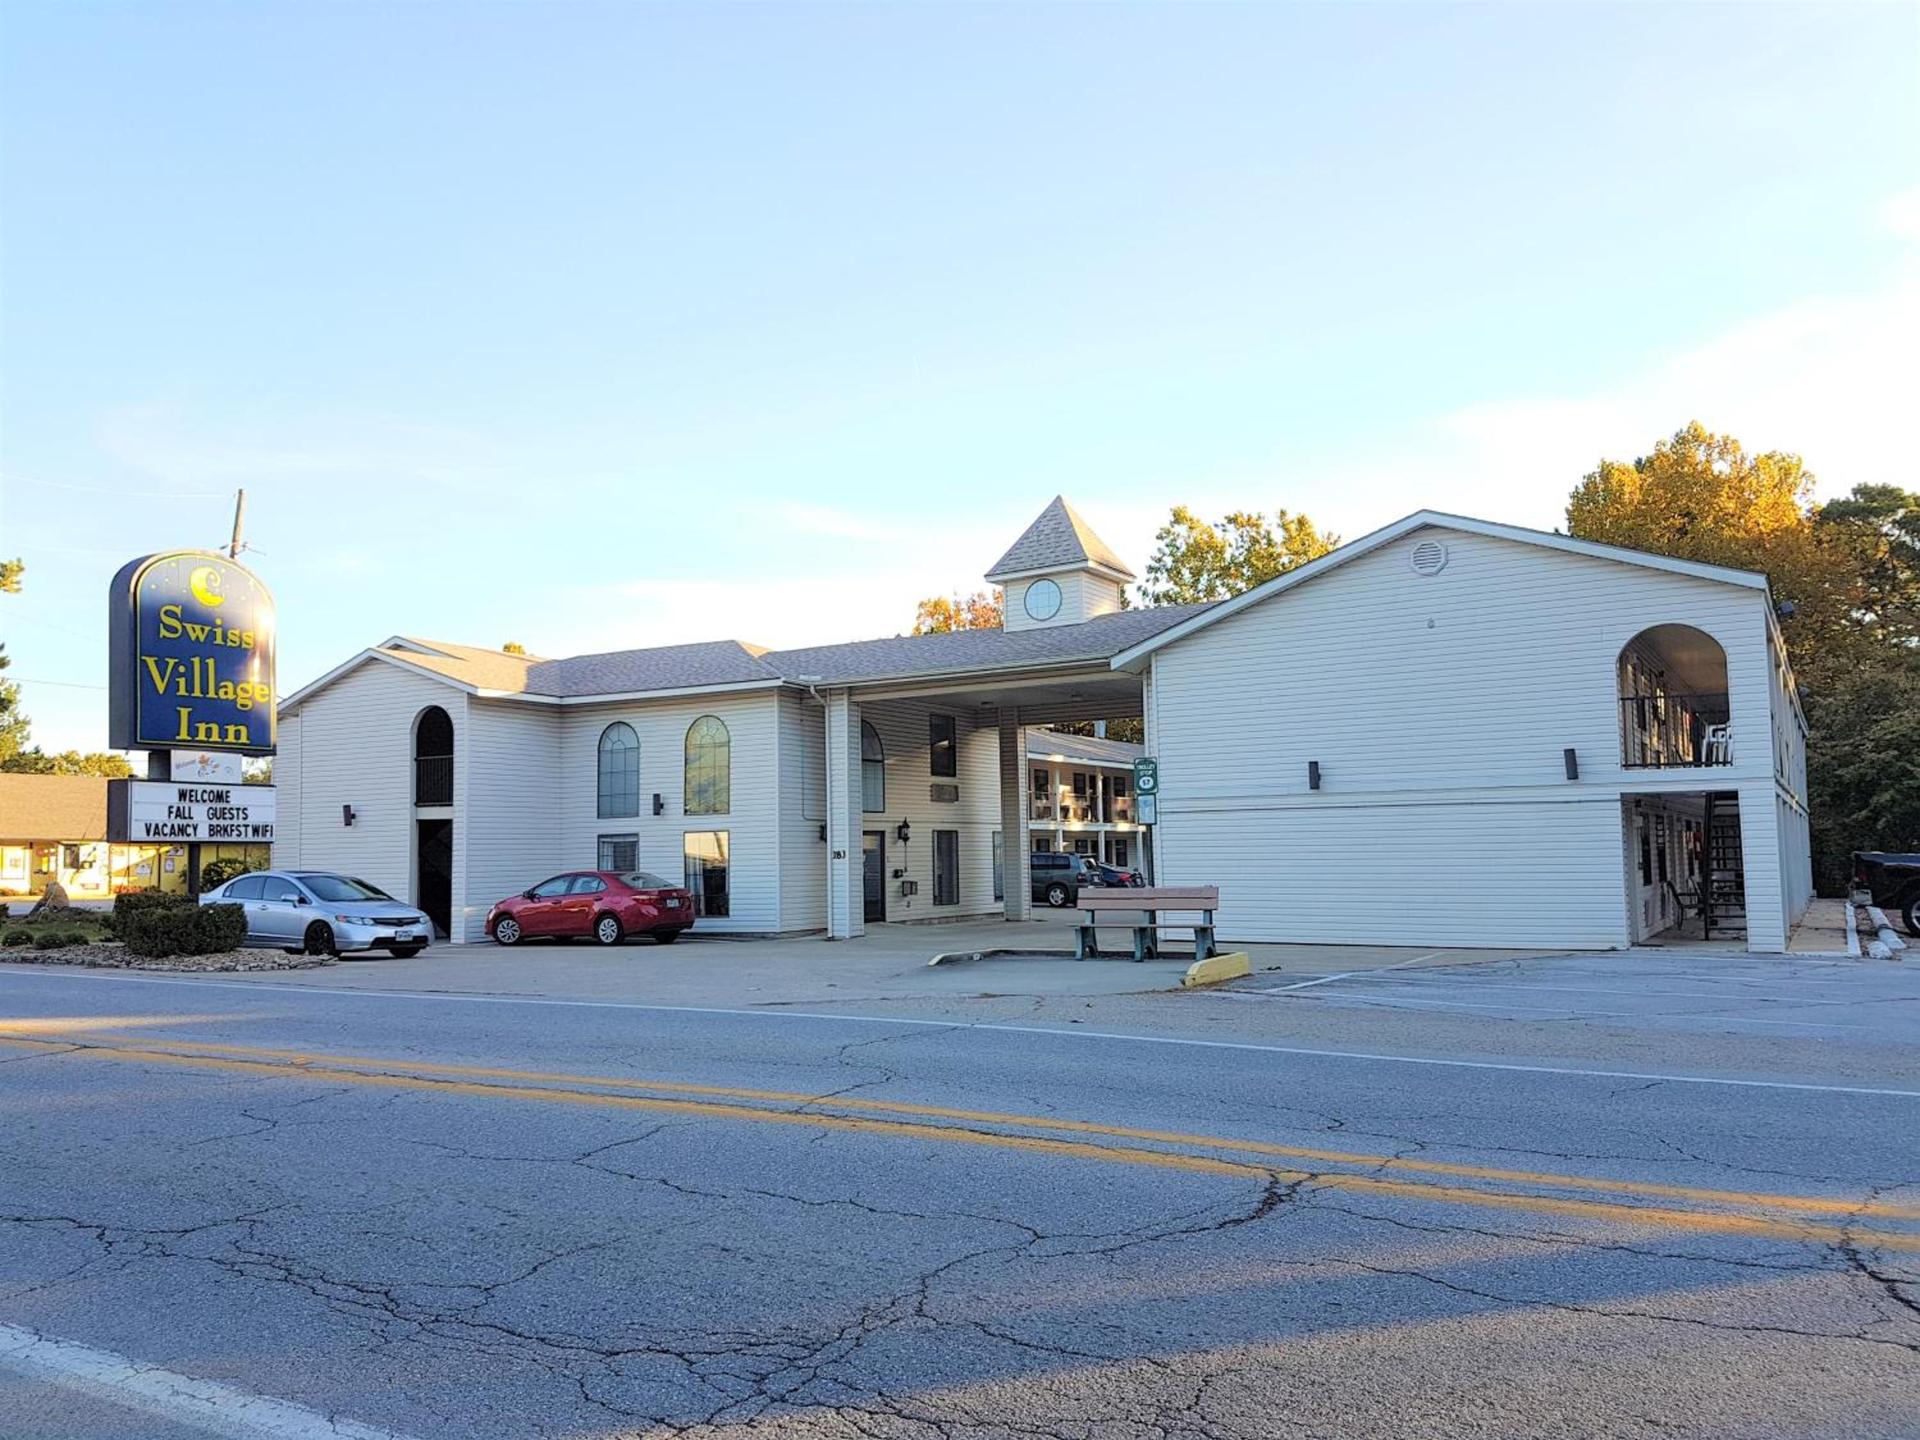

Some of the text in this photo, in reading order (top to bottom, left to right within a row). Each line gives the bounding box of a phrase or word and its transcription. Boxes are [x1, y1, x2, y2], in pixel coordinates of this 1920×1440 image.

[159, 604, 255, 649] Swiss
[141, 655, 270, 710] Village
[175, 706, 250, 744] Inn
[178, 788, 231, 803] WELCOME
[168, 805, 248, 820] FALL GUESTS
[145, 823, 274, 838] VACANCY BRKFST WIFI
